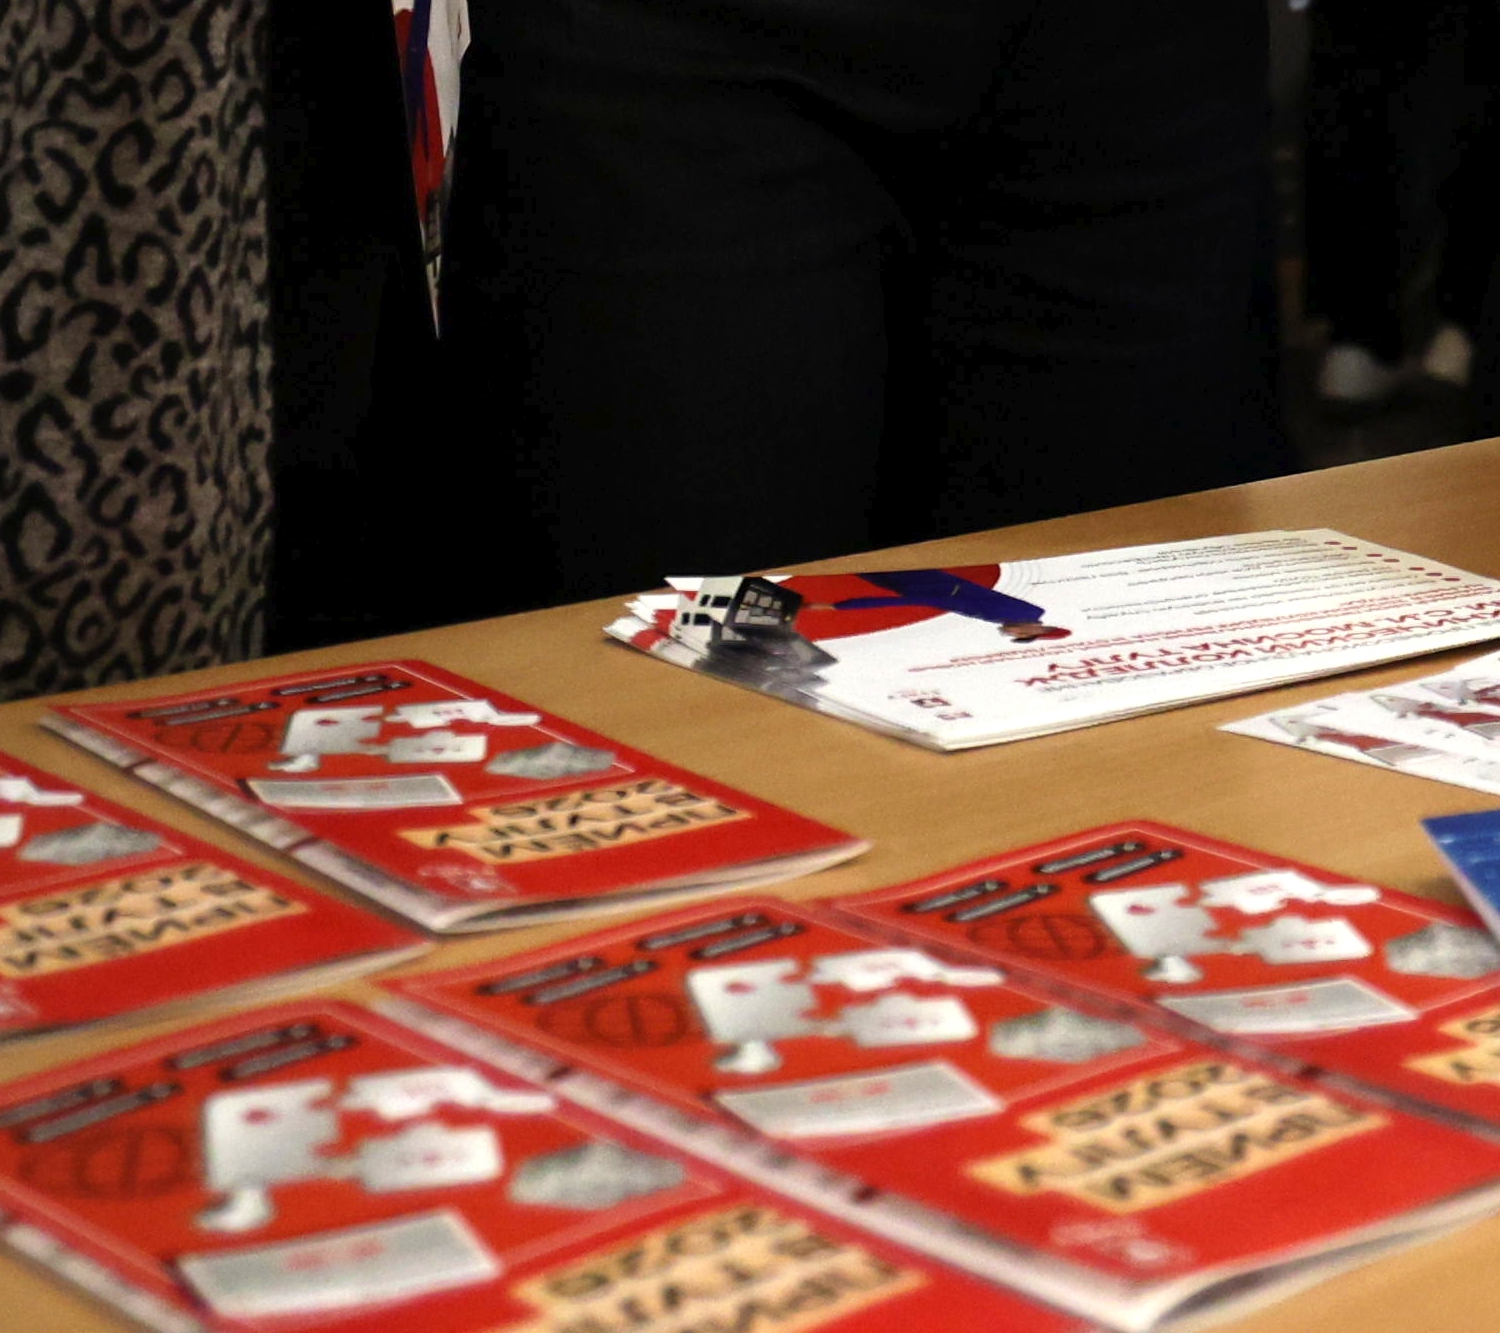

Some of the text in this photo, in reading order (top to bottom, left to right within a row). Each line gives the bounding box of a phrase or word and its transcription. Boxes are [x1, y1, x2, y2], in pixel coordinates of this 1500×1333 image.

[1182, 621, 1376, 653] МОСИНА
[1015, 649, 1253, 687] КОЛЛЕДЖ
[1046, 648, 1183, 673] ТУЛГУ
